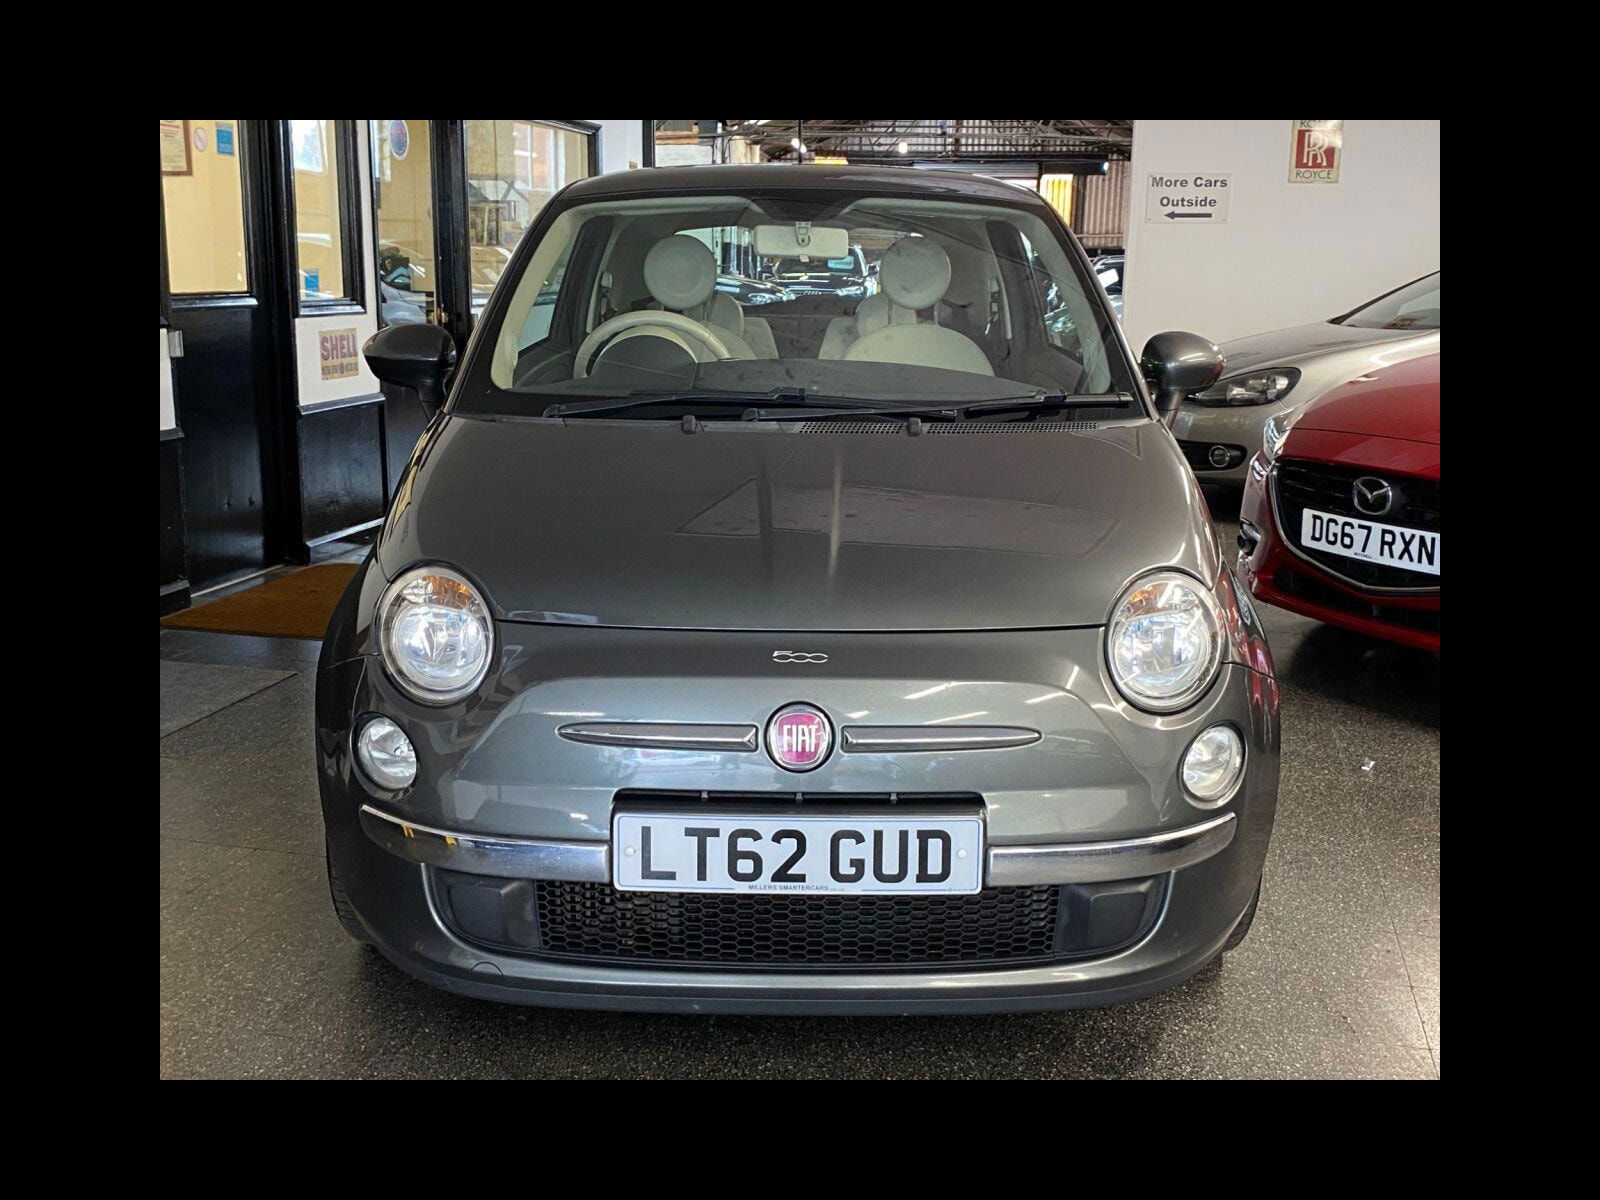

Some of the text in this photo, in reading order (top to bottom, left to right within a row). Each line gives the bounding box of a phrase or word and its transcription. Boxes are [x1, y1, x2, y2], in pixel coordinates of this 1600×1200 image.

[1295, 169, 1333, 180] ROYCE
[1151, 176, 1228, 188] More Cars
[1159, 195, 1217, 207] Outside
[320, 333, 359, 361] SHELL
[1310, 513, 1436, 567] DG67 RXN
[772, 650, 829, 664] 500
[782, 724, 819, 753] FIAT
[641, 825, 952, 884] LT62 GUD
[778, 884, 829, 892] SMARTERCARS
